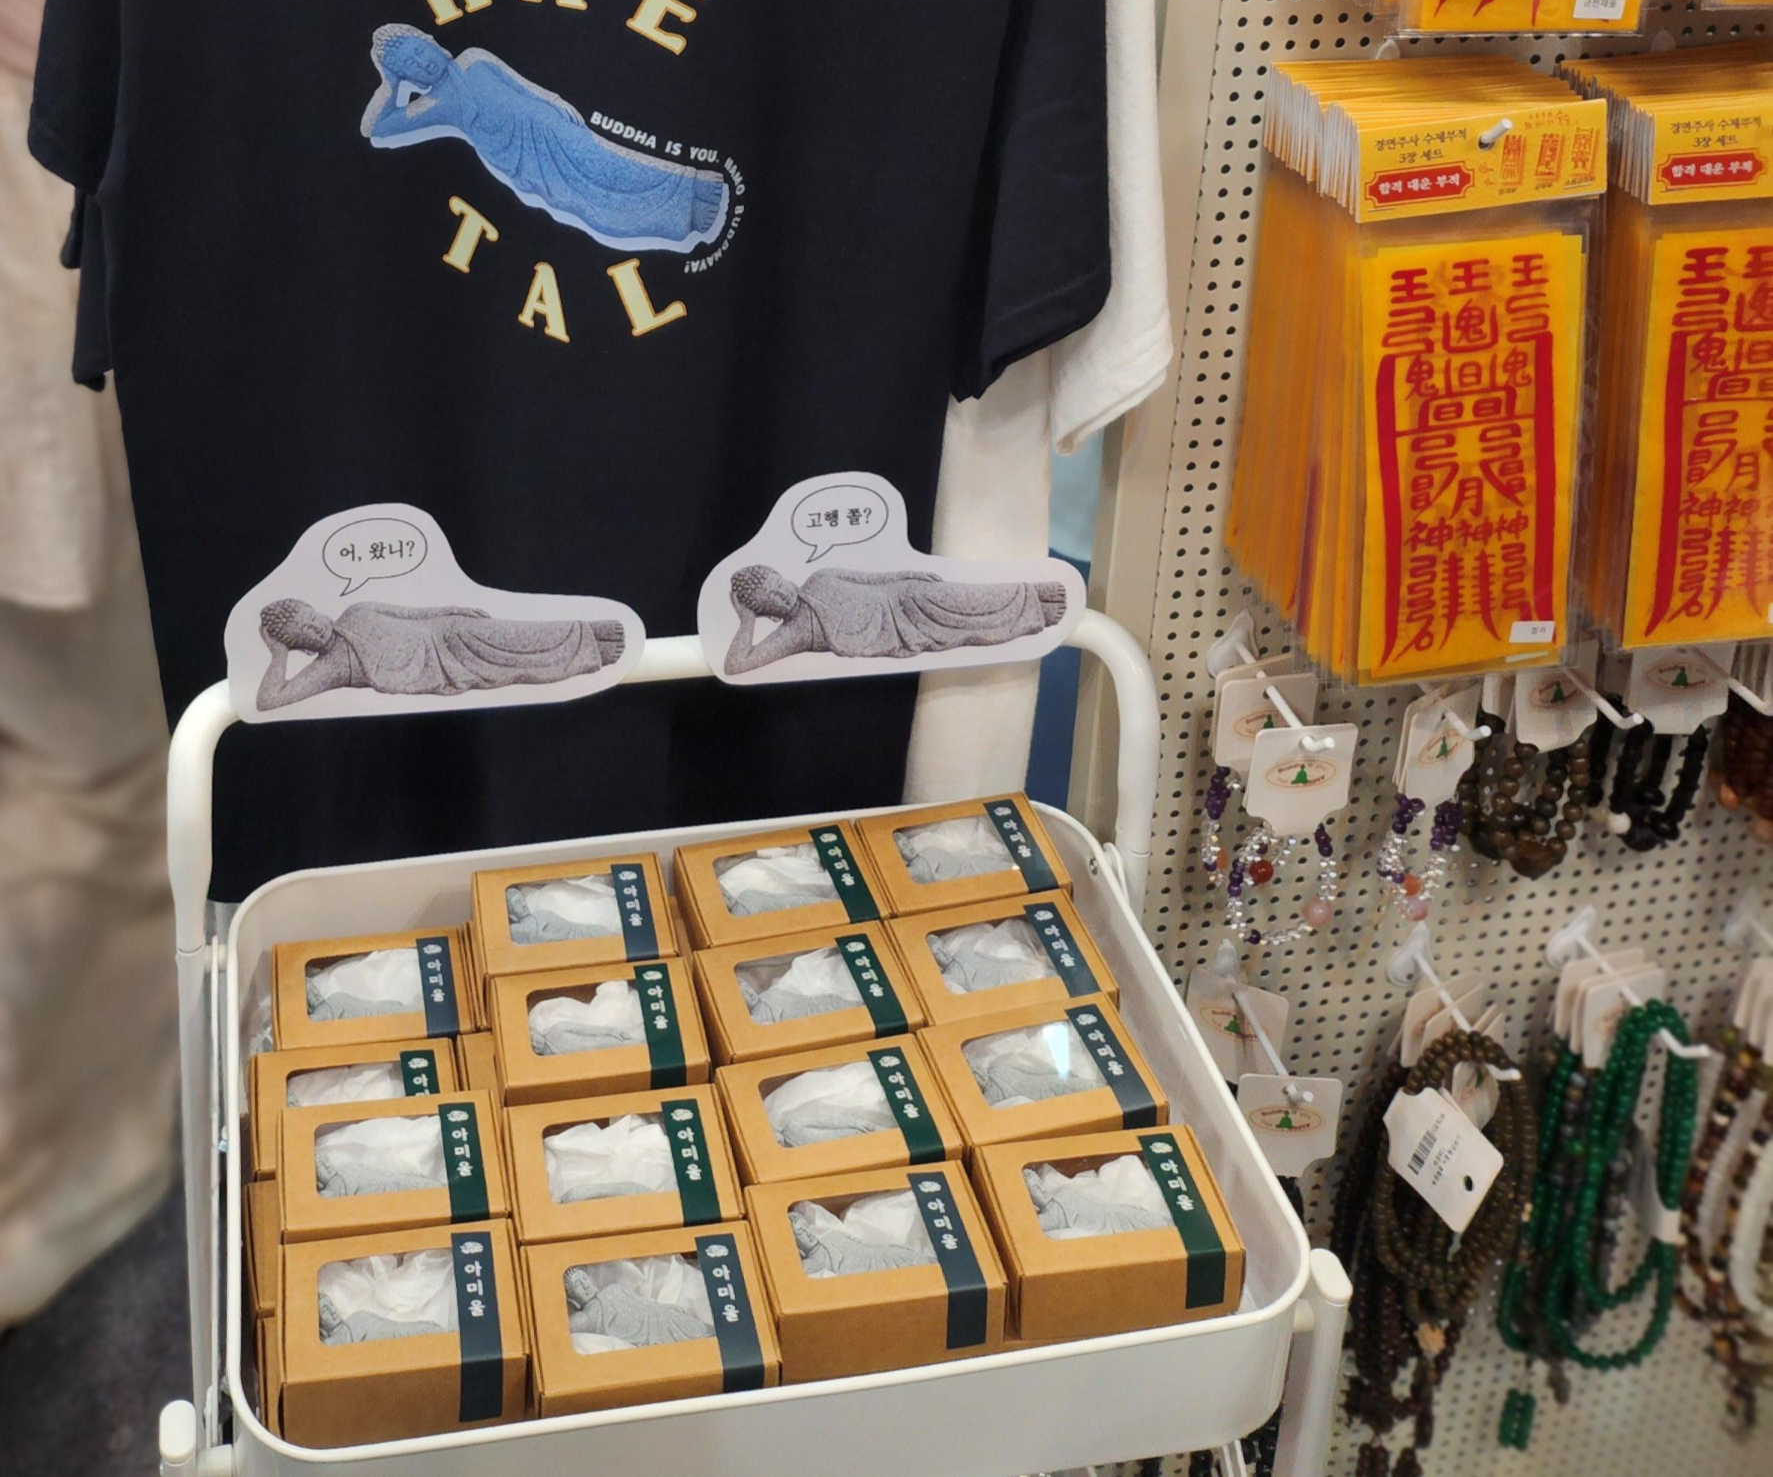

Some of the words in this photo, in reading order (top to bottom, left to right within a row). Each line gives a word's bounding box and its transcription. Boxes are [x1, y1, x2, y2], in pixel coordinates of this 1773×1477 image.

[590, 111, 657, 149] BUDDHA
[665, 140, 683, 156] IS
[689, 146, 719, 163] YOU.
[1420, 148, 1444, 161] 세트
[1378, 180, 1402, 195] 합격
[1406, 177, 1432, 191] 대운
[1435, 173, 1460, 188] 부적
[442, 195, 688, 343] TAL
[806, 508, 840, 528] 고행
[339, 543, 362, 562] 어,
[368, 539, 415, 561] 왔니?
